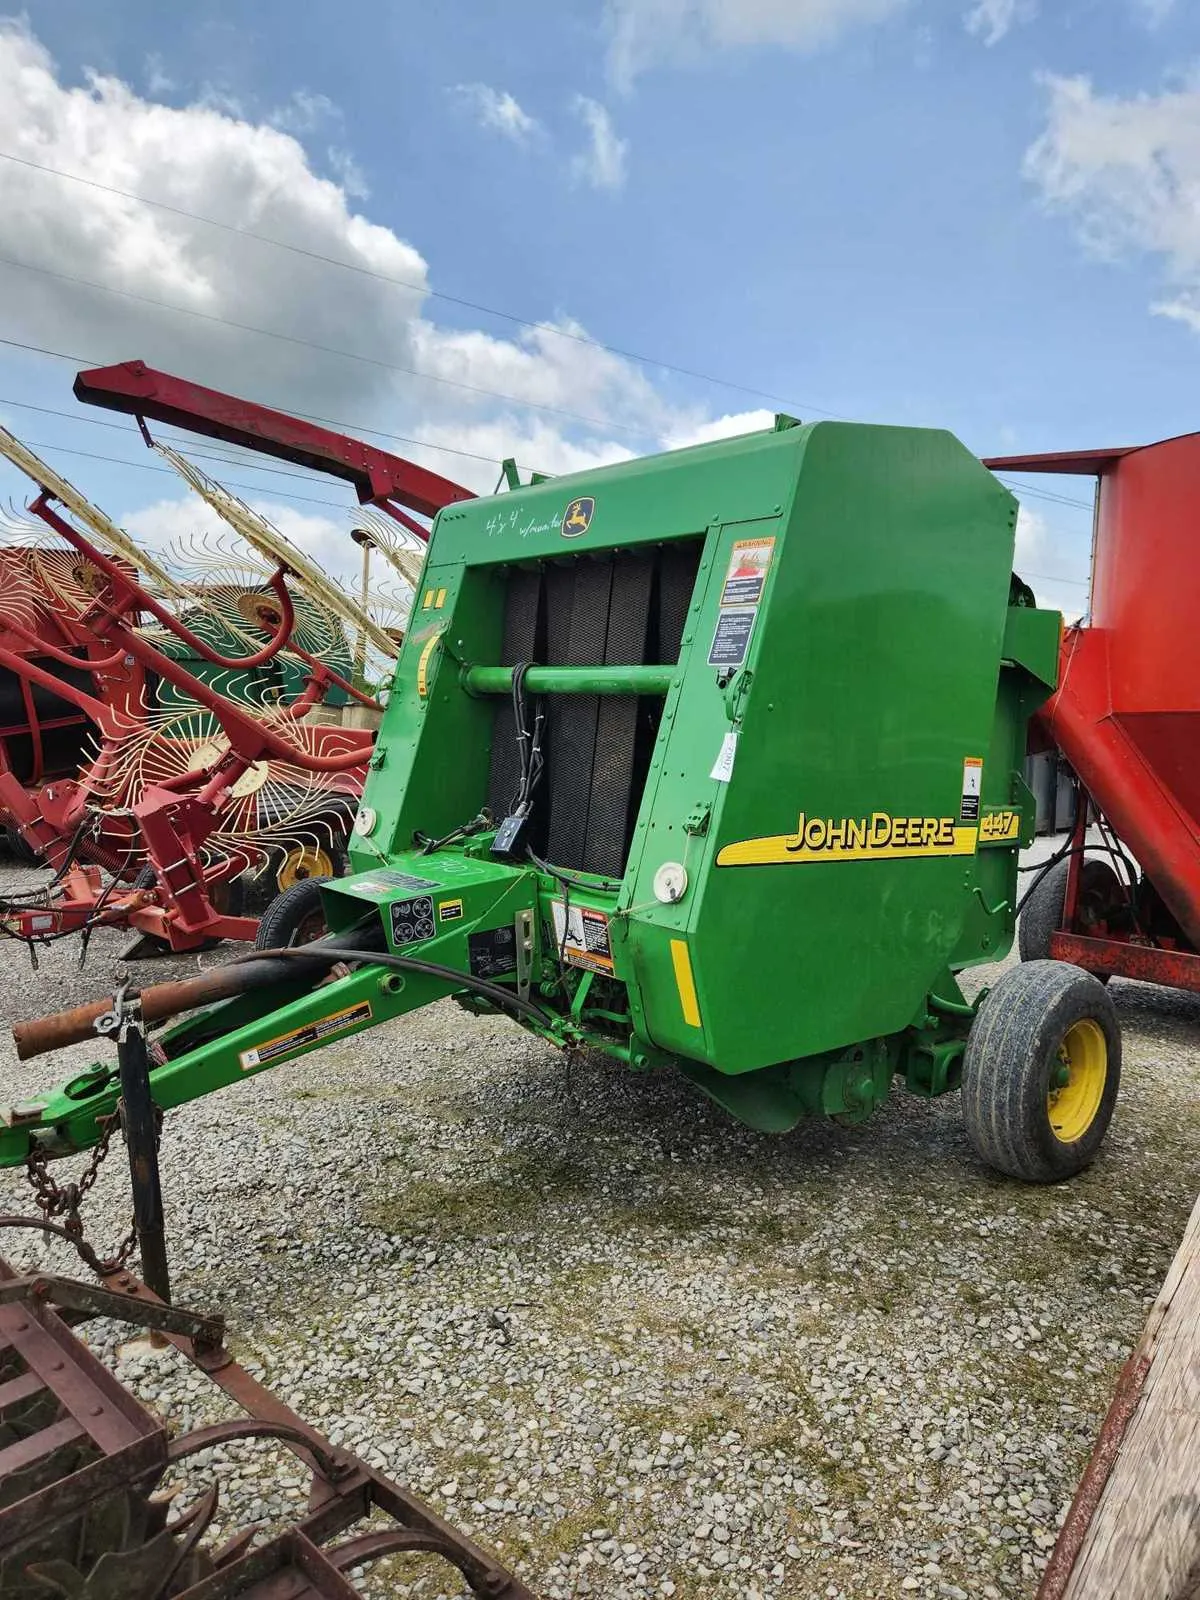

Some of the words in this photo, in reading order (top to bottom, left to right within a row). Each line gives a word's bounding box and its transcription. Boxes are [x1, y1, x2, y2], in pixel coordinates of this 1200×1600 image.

[786, 812, 866, 851] JOHN
[871, 812, 955, 849] DEERE
[983, 811, 1013, 835] 447
